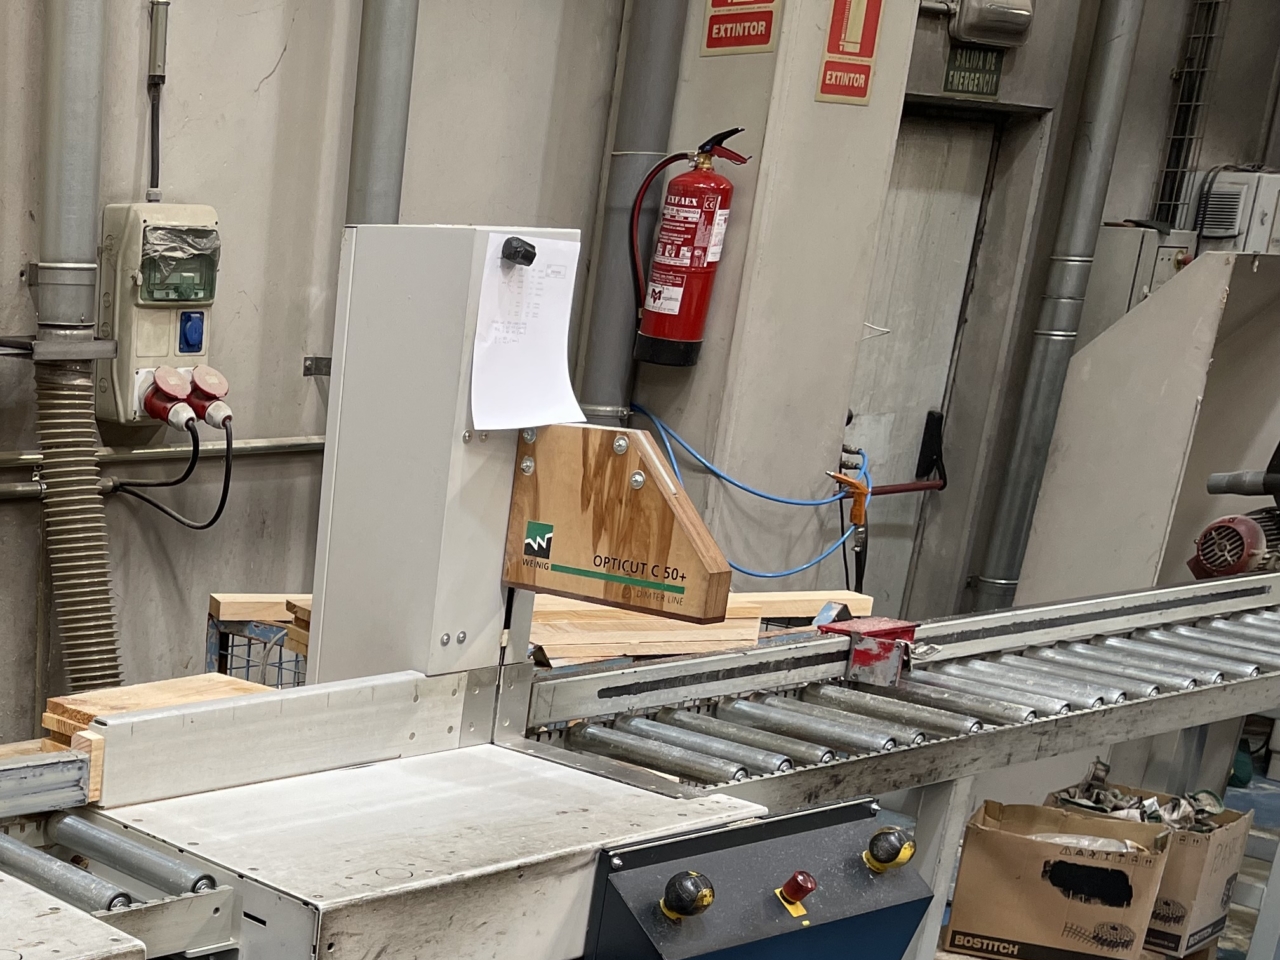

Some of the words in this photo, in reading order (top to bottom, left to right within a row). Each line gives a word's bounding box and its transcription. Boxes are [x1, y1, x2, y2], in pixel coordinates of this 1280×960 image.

[712, 21, 766, 38] EXTINTOR
[955, 48, 984, 69] SALIDA
[986, 51, 997, 70] DE
[825, 71, 865, 88] EXTINTOR
[947, 70, 997, 93] EMERGENCIA
[522, 558, 550, 571] WEINIG
[593, 554, 647, 576] OPTICUT
[651, 564, 659, 578] C
[663, 566, 687, 582] 50+
[636, 589, 666, 604] DIMTER
[667, 594, 684, 606] LINE
[954, 934, 1019, 956] BOSTITCH
